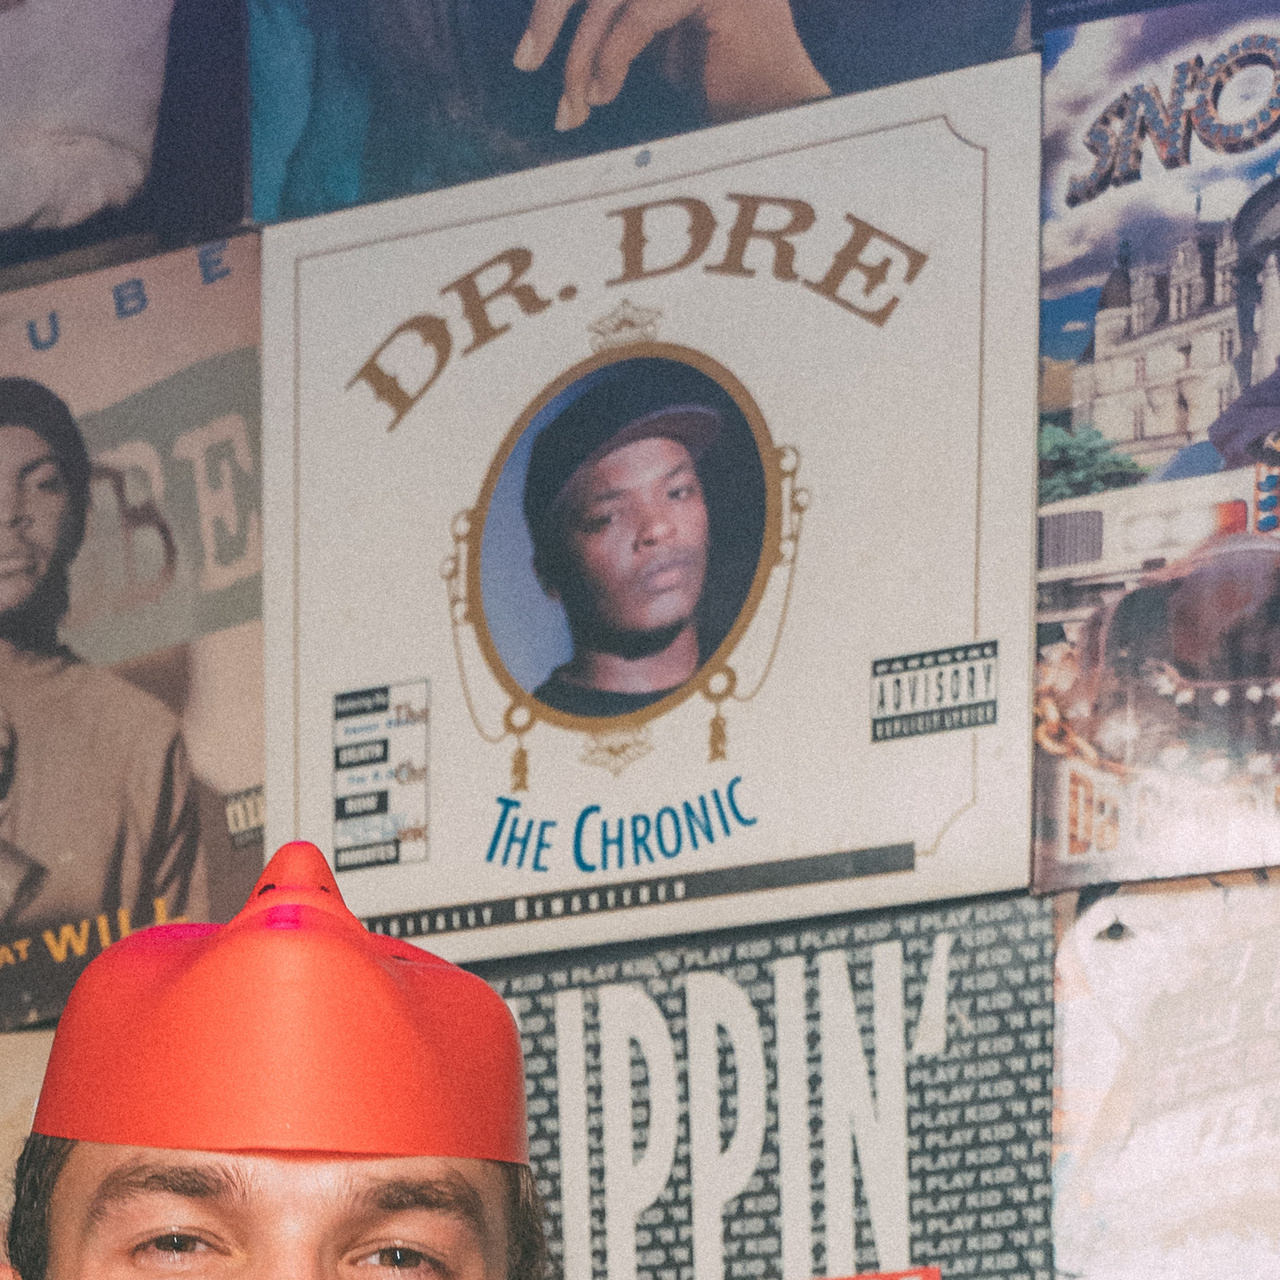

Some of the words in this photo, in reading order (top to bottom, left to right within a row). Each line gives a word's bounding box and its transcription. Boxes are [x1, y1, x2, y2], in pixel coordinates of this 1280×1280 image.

[346, 246, 577, 433] DR.
[605, 192, 930, 328] DRE
[876, 663, 992, 713] ADVISORY
[485, 796, 557, 872] THE
[573, 776, 758, 873] CHRONIC
